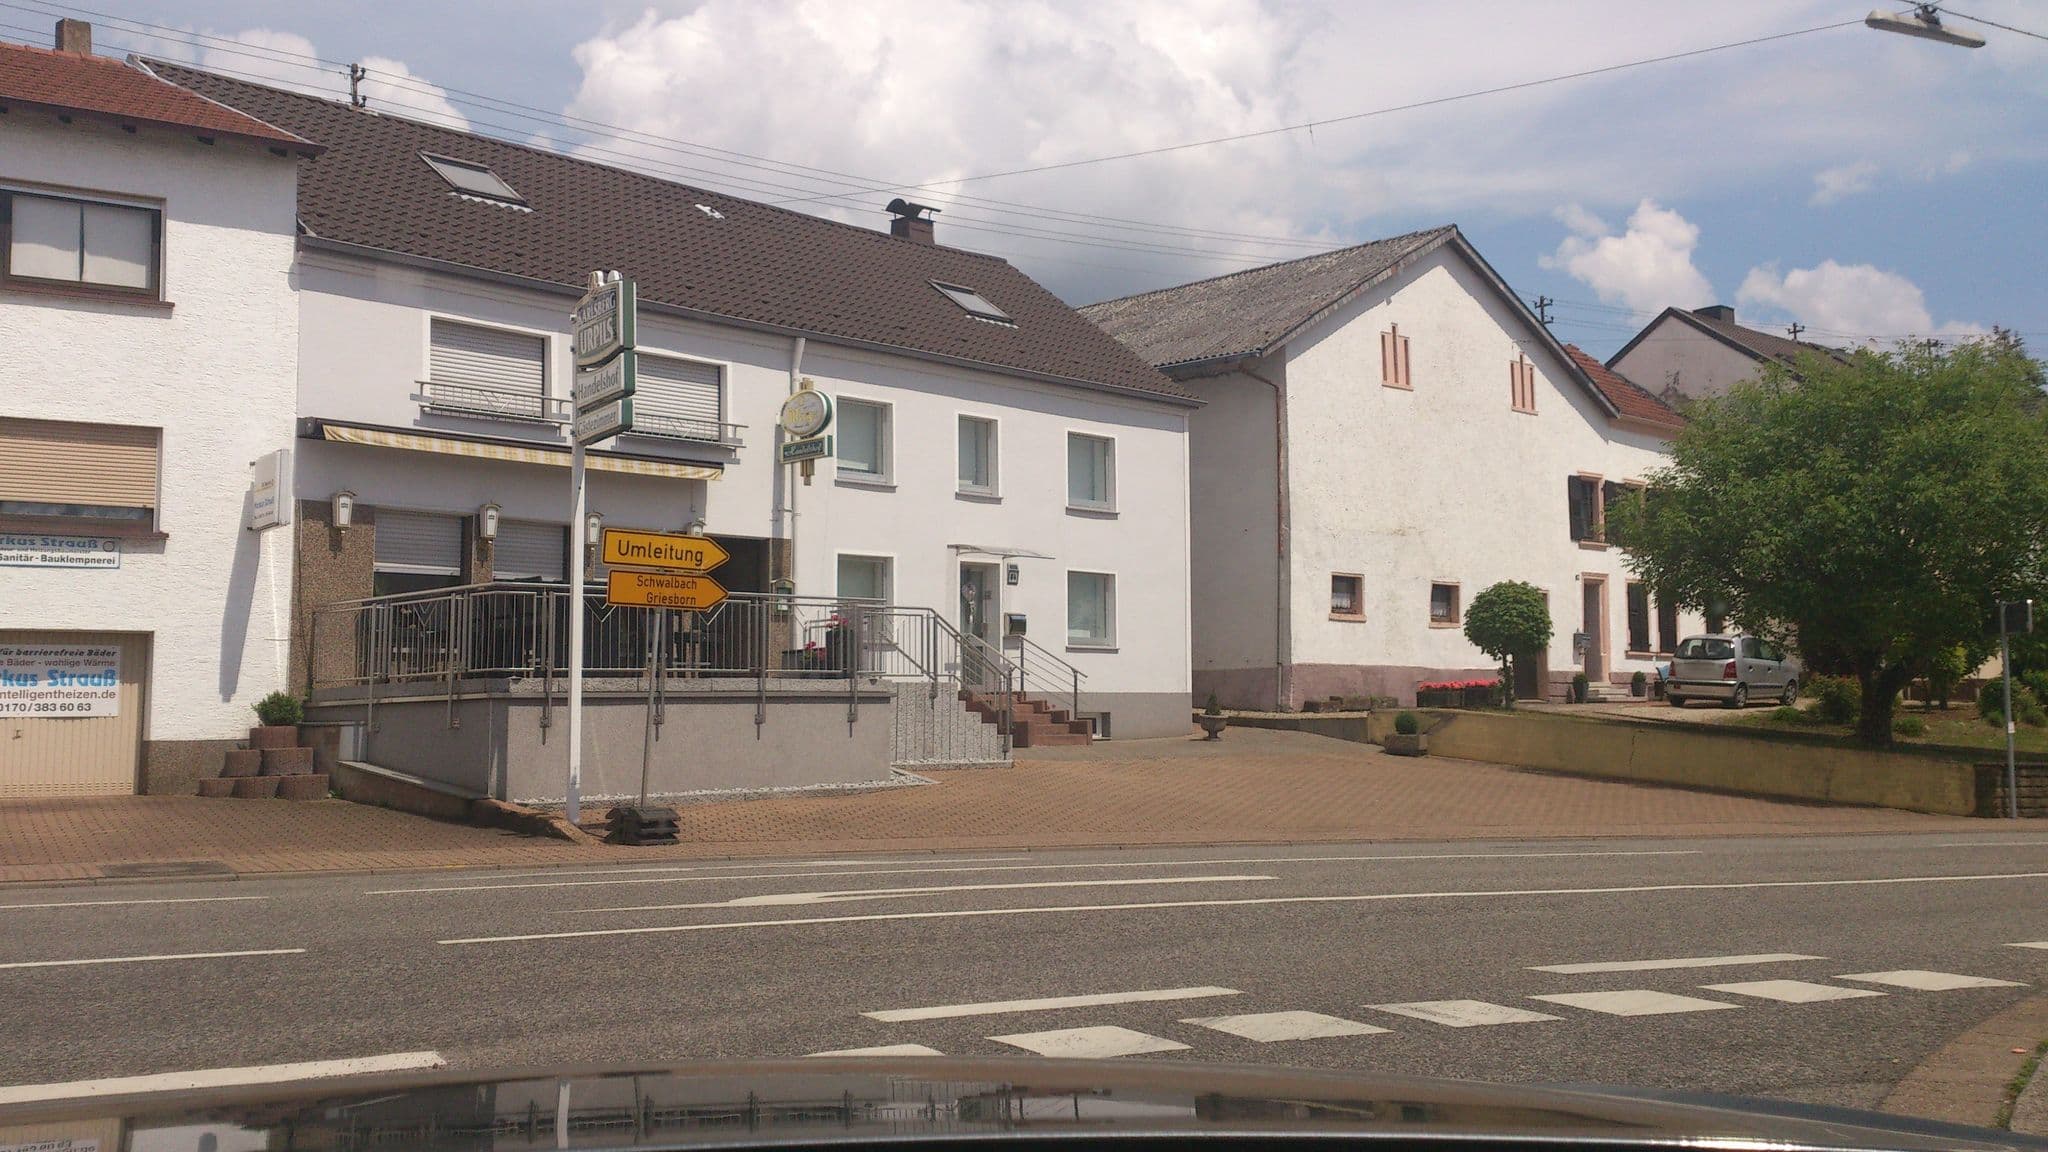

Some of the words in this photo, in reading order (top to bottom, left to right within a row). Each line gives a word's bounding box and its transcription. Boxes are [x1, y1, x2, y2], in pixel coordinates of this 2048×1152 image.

[580, 317, 614, 354] URPILS
[578, 365, 619, 398] Handelshof
[41, 537, 98, 548] Strauß
[41, 554, 115, 565] Bauklempnerei
[617, 539, 703, 567] Umleitung
[636, 575, 697, 590] Schwalbach
[646, 592, 697, 606] Griesborn
[16, 649, 85, 657] barrierefreie
[87, 649, 117, 657] Bäder
[0, 669, 38, 687] kus
[47, 669, 116, 687] Strauß
[60, 702, 74, 712] 60
[77, 702, 91, 712] 63
